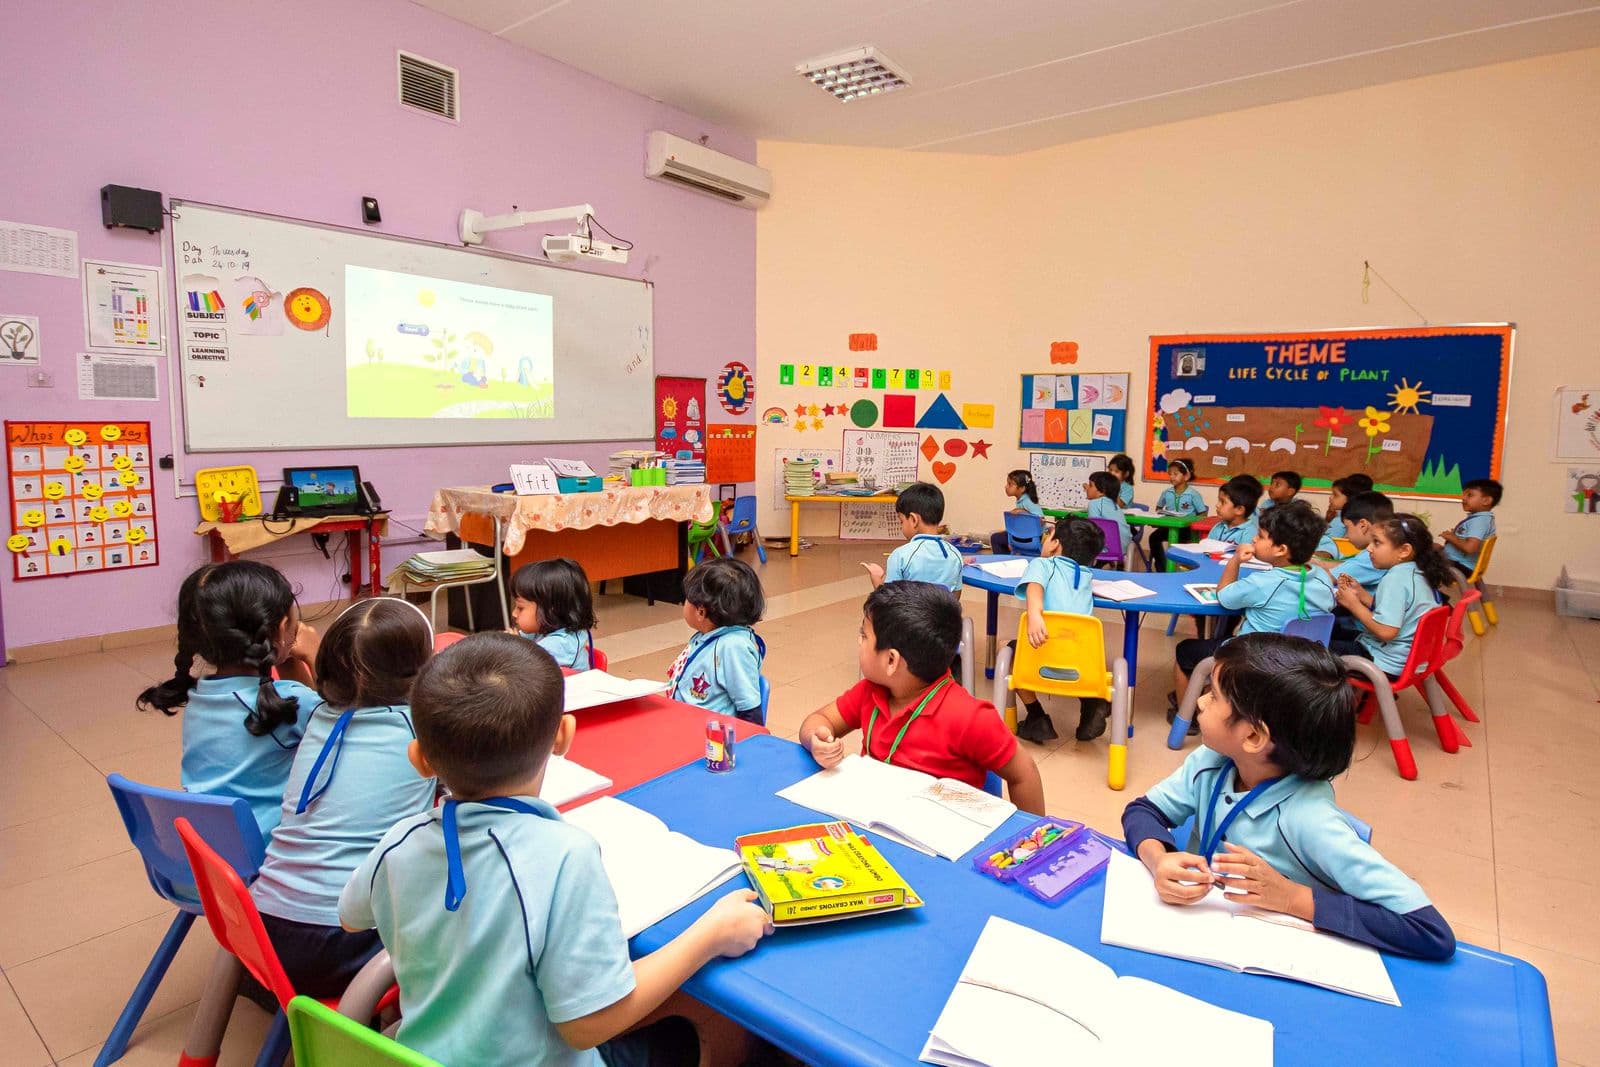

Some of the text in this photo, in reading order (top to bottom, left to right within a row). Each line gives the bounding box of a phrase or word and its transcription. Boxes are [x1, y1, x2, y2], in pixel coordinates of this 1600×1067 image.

[182, 241, 202, 256] Day
[187, 312, 225, 320] SUBJECT
[193, 331, 220, 339] TOPIC
[1264, 341, 1346, 366] THEME
[784, 365, 951, 384] 1 2 3 4 5 6 7 8 9 10
[1228, 367, 1257, 380] LIFE
[1265, 367, 1309, 381] CYCLE
[1339, 368, 1389, 382] PLANT
[865, 432, 902, 441] NUMBERS
[526, 473, 551, 491] fit
[820, 901, 849, 910] CRAYONS
